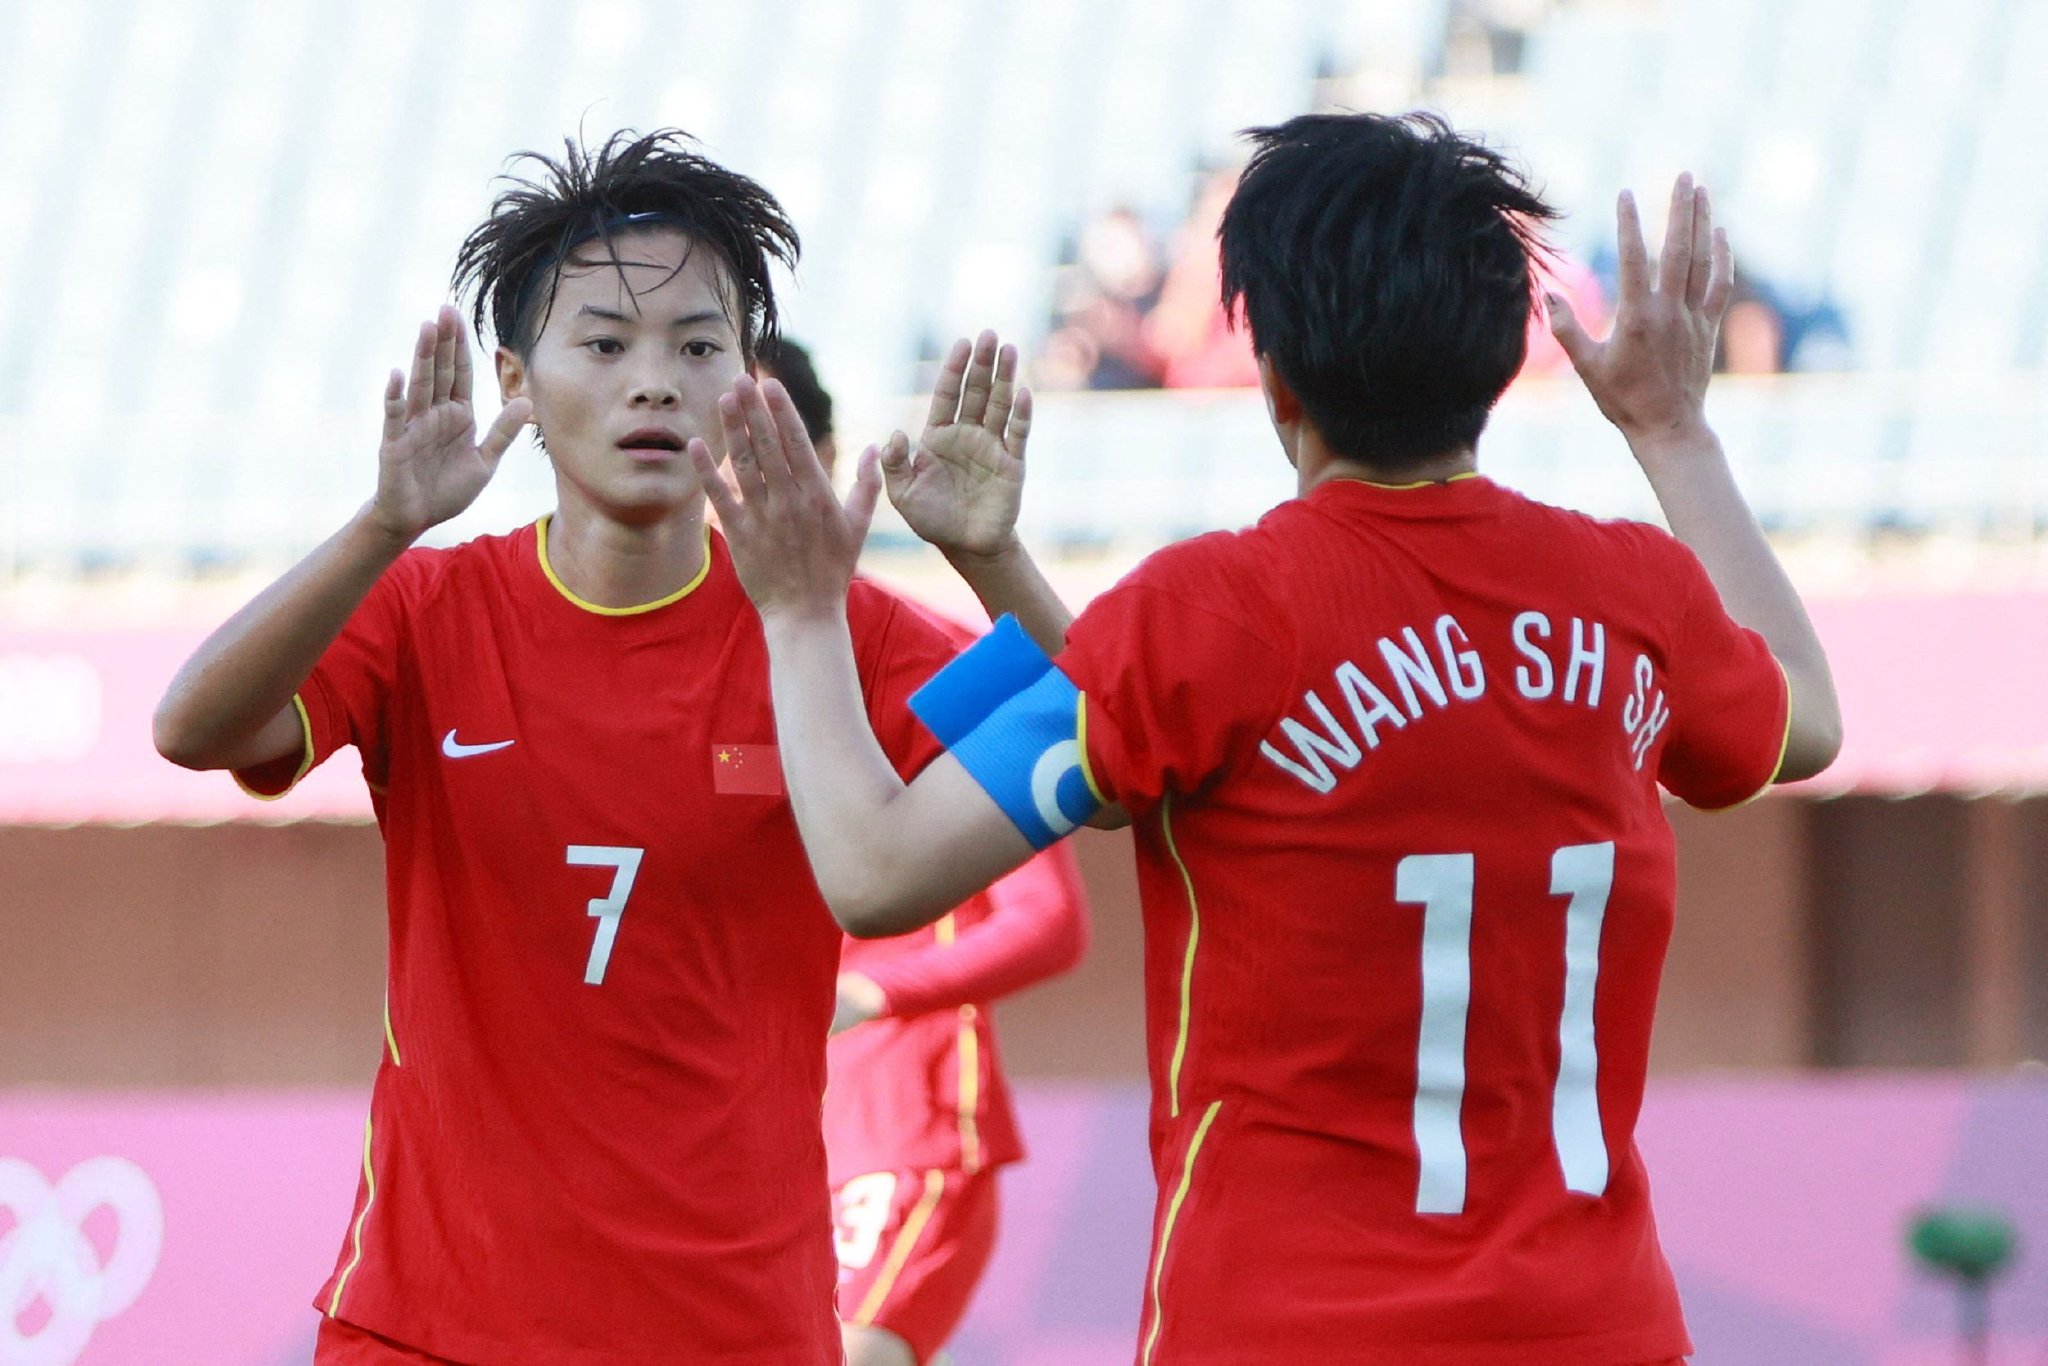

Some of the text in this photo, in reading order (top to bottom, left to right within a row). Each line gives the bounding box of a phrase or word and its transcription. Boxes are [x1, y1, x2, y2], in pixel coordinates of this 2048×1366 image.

[1260, 614, 1486, 794] WANG
[1512, 611, 1605, 708] SH
[566, 845, 645, 985] 7
[1396, 840, 1615, 1214] 11
